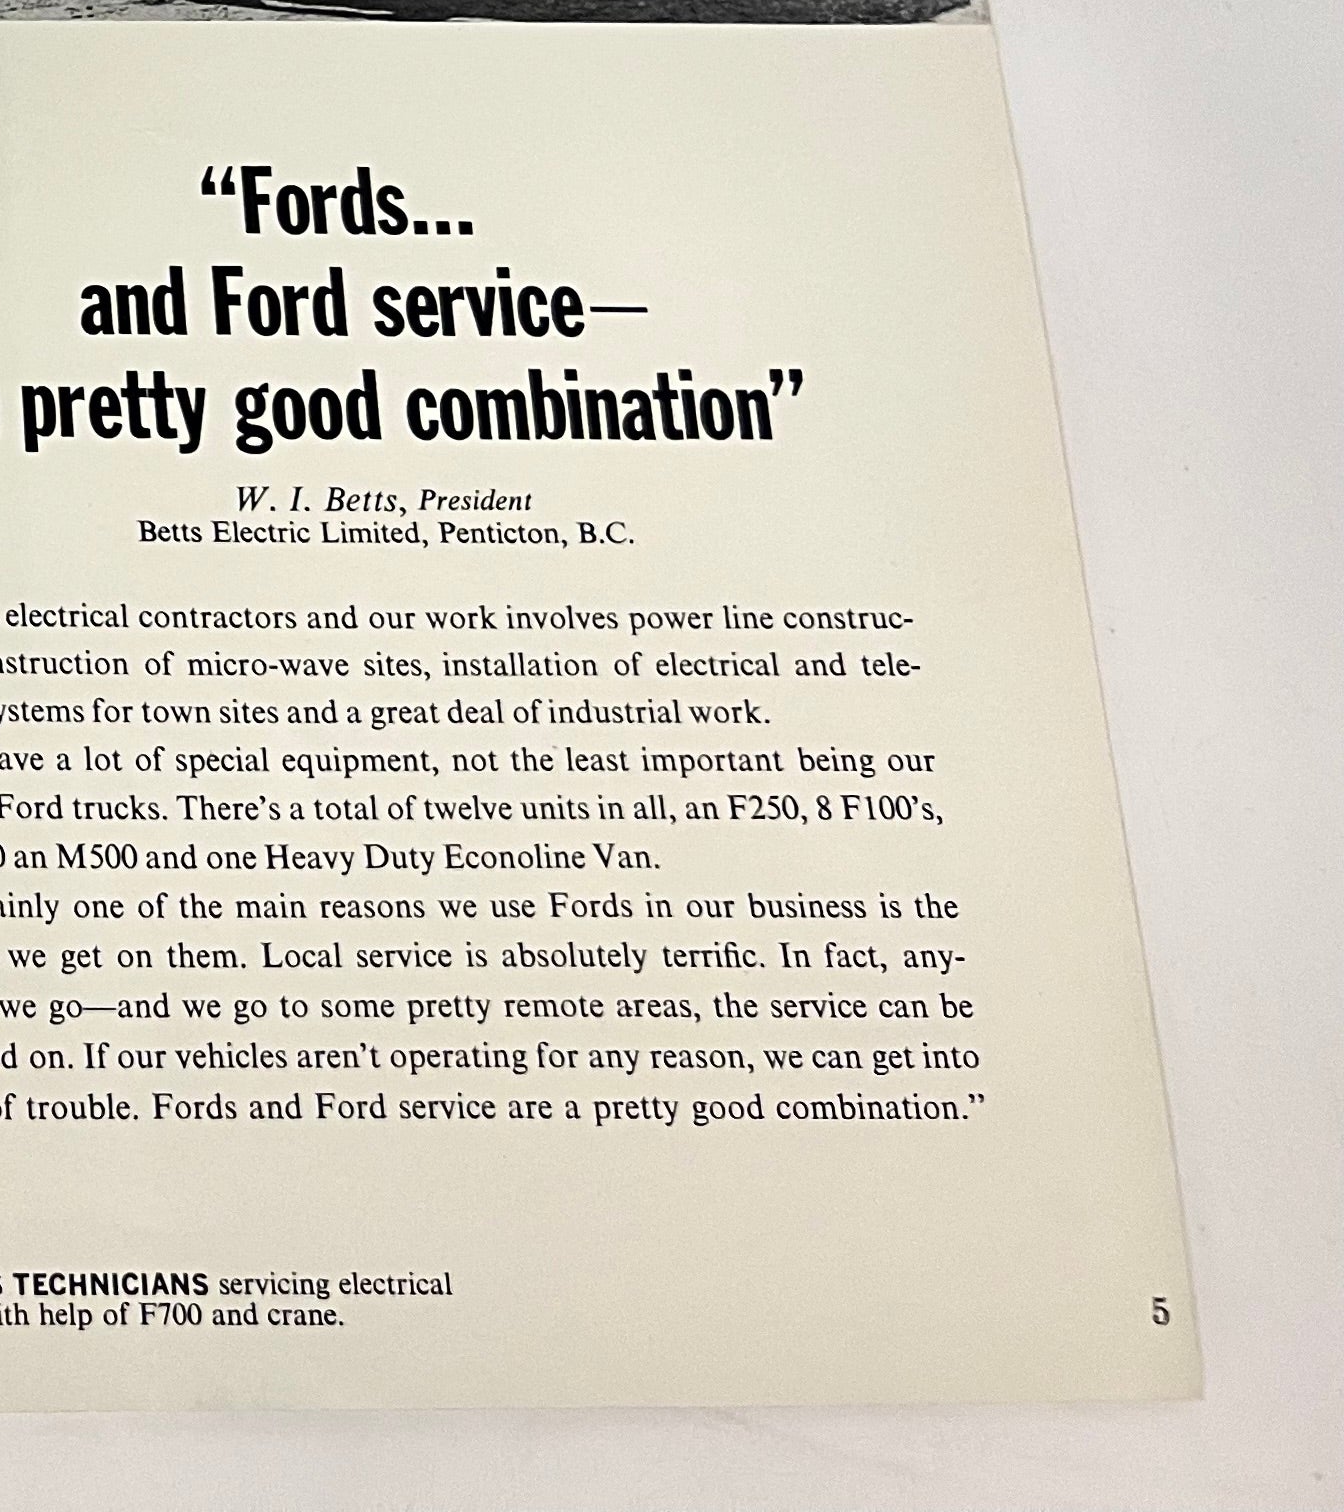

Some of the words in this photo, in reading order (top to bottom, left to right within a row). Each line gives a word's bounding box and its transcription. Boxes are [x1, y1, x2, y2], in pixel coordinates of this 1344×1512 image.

[80, 265, 189, 336] and
[210, 265, 349, 337] Ford
[20, 369, 207, 455] pretty
[234, 368, 383, 455] good
[236, 485, 276, 512] W.
[289, 485, 311, 512] I.
[323, 486, 407, 518] Betts,
[417, 488, 532, 512] President
[136, 519, 203, 543] Betts
[210, 520, 311, 544] Electric
[319, 520, 429, 549] Limited,
[436, 521, 568, 550] Penticton,
[575, 520, 635, 545] B.C.
[5, 601, 130, 629] electrical
[138, 607, 298, 630] contractors
[307, 604, 359, 630] and
[368, 611, 416, 630] our
[424, 604, 498, 630] work
[505, 604, 619, 630] involves
[628, 611, 714, 637] power
[722, 604, 774, 630] line
[783, 607, 914, 630] construc-
[144, 650, 175, 677] of
[186, 650, 350, 677] micro-wave
[363, 650, 431, 682] sites,
[441, 651, 599, 677] installation
[613, 651, 644, 677] of
[655, 651, 781, 677] electrical
[794, 651, 847, 677] and
[860, 651, 921, 677] tele-
[92, 696, 134, 724] for
[141, 701, 212, 724] town
[219, 698, 280, 725] sites
[287, 698, 339, 725] and
[346, 705, 363, 724] a
[370, 702, 441, 731] great
[447, 698, 505, 724] deal
[512, 698, 543, 725] of
[547, 698, 683, 724] industrial
[687, 698, 771, 725] work.
[56, 752, 73, 772] a
[83, 745, 124, 772] lot
[135, 745, 166, 772] of
[175, 745, 271, 779] special
[281, 746, 440, 780] equipment,
[451, 750, 500, 772] not
[509, 746, 554, 772] the
[565, 746, 631, 772] least
[641, 745, 785, 780] important
[796, 745, 877, 779] being
[887, 753, 936, 773] our
[71, 794, 168, 821] trucks.
[289, 802, 306, 821] a
[313, 794, 380, 821] total
[387, 794, 418, 821] of
[423, 794, 513, 821] twelve
[519, 794, 591, 821] units
[597, 794, 626, 820] in
[633, 794, 677, 826] all,
[685, 801, 721, 821] an
[726, 794, 808, 826] F250,
[815, 794, 833, 821] 8
[13, 849, 49, 869] an
[55, 842, 138, 870] M500
[145, 843, 198, 870] and
[206, 851, 257, 870] one
[263, 843, 356, 877] Heavy
[362, 843, 436, 877] Duty
[442, 842, 586, 870] Econoline
[591, 842, 661, 870] Van.
[73, 899, 125, 919] one
[137, 891, 169, 919] of
[178, 892, 223, 920] the
[234, 891, 308, 919] main
[319, 899, 426, 919] reasons
[437, 899, 478, 919] we
[489, 899, 536, 919] use
[547, 891, 634, 919] Fords
[644, 891, 675, 919] in
[686, 899, 736, 919] our
[747, 891, 867, 919] business
[879, 891, 903, 919] is
[913, 892, 960, 919] the
[26, 1092, 139, 1121] trouble.
[151, 1092, 238, 1121] Fords
[249, 1092, 304, 1120] and
[314, 1092, 388, 1120] Ford
[398, 1091, 497, 1120] service
[508, 1099, 553, 1120] are
[564, 1100, 582, 1120] a
[592, 1096, 679, 1127] pretty
[692, 1092, 766, 1127] good
[11, 1271, 209, 1297] TECHNICIANS
[218, 1271, 331, 1301] servicing
[338, 1271, 454, 1296] electrical
[38, 1301, 93, 1332] help
[102, 1301, 131, 1327] of
[138, 1301, 203, 1326] F700
[212, 1301, 260, 1327] and
[267, 1307, 345, 1327] crane.
[1151, 1296, 1171, 1326] 5
